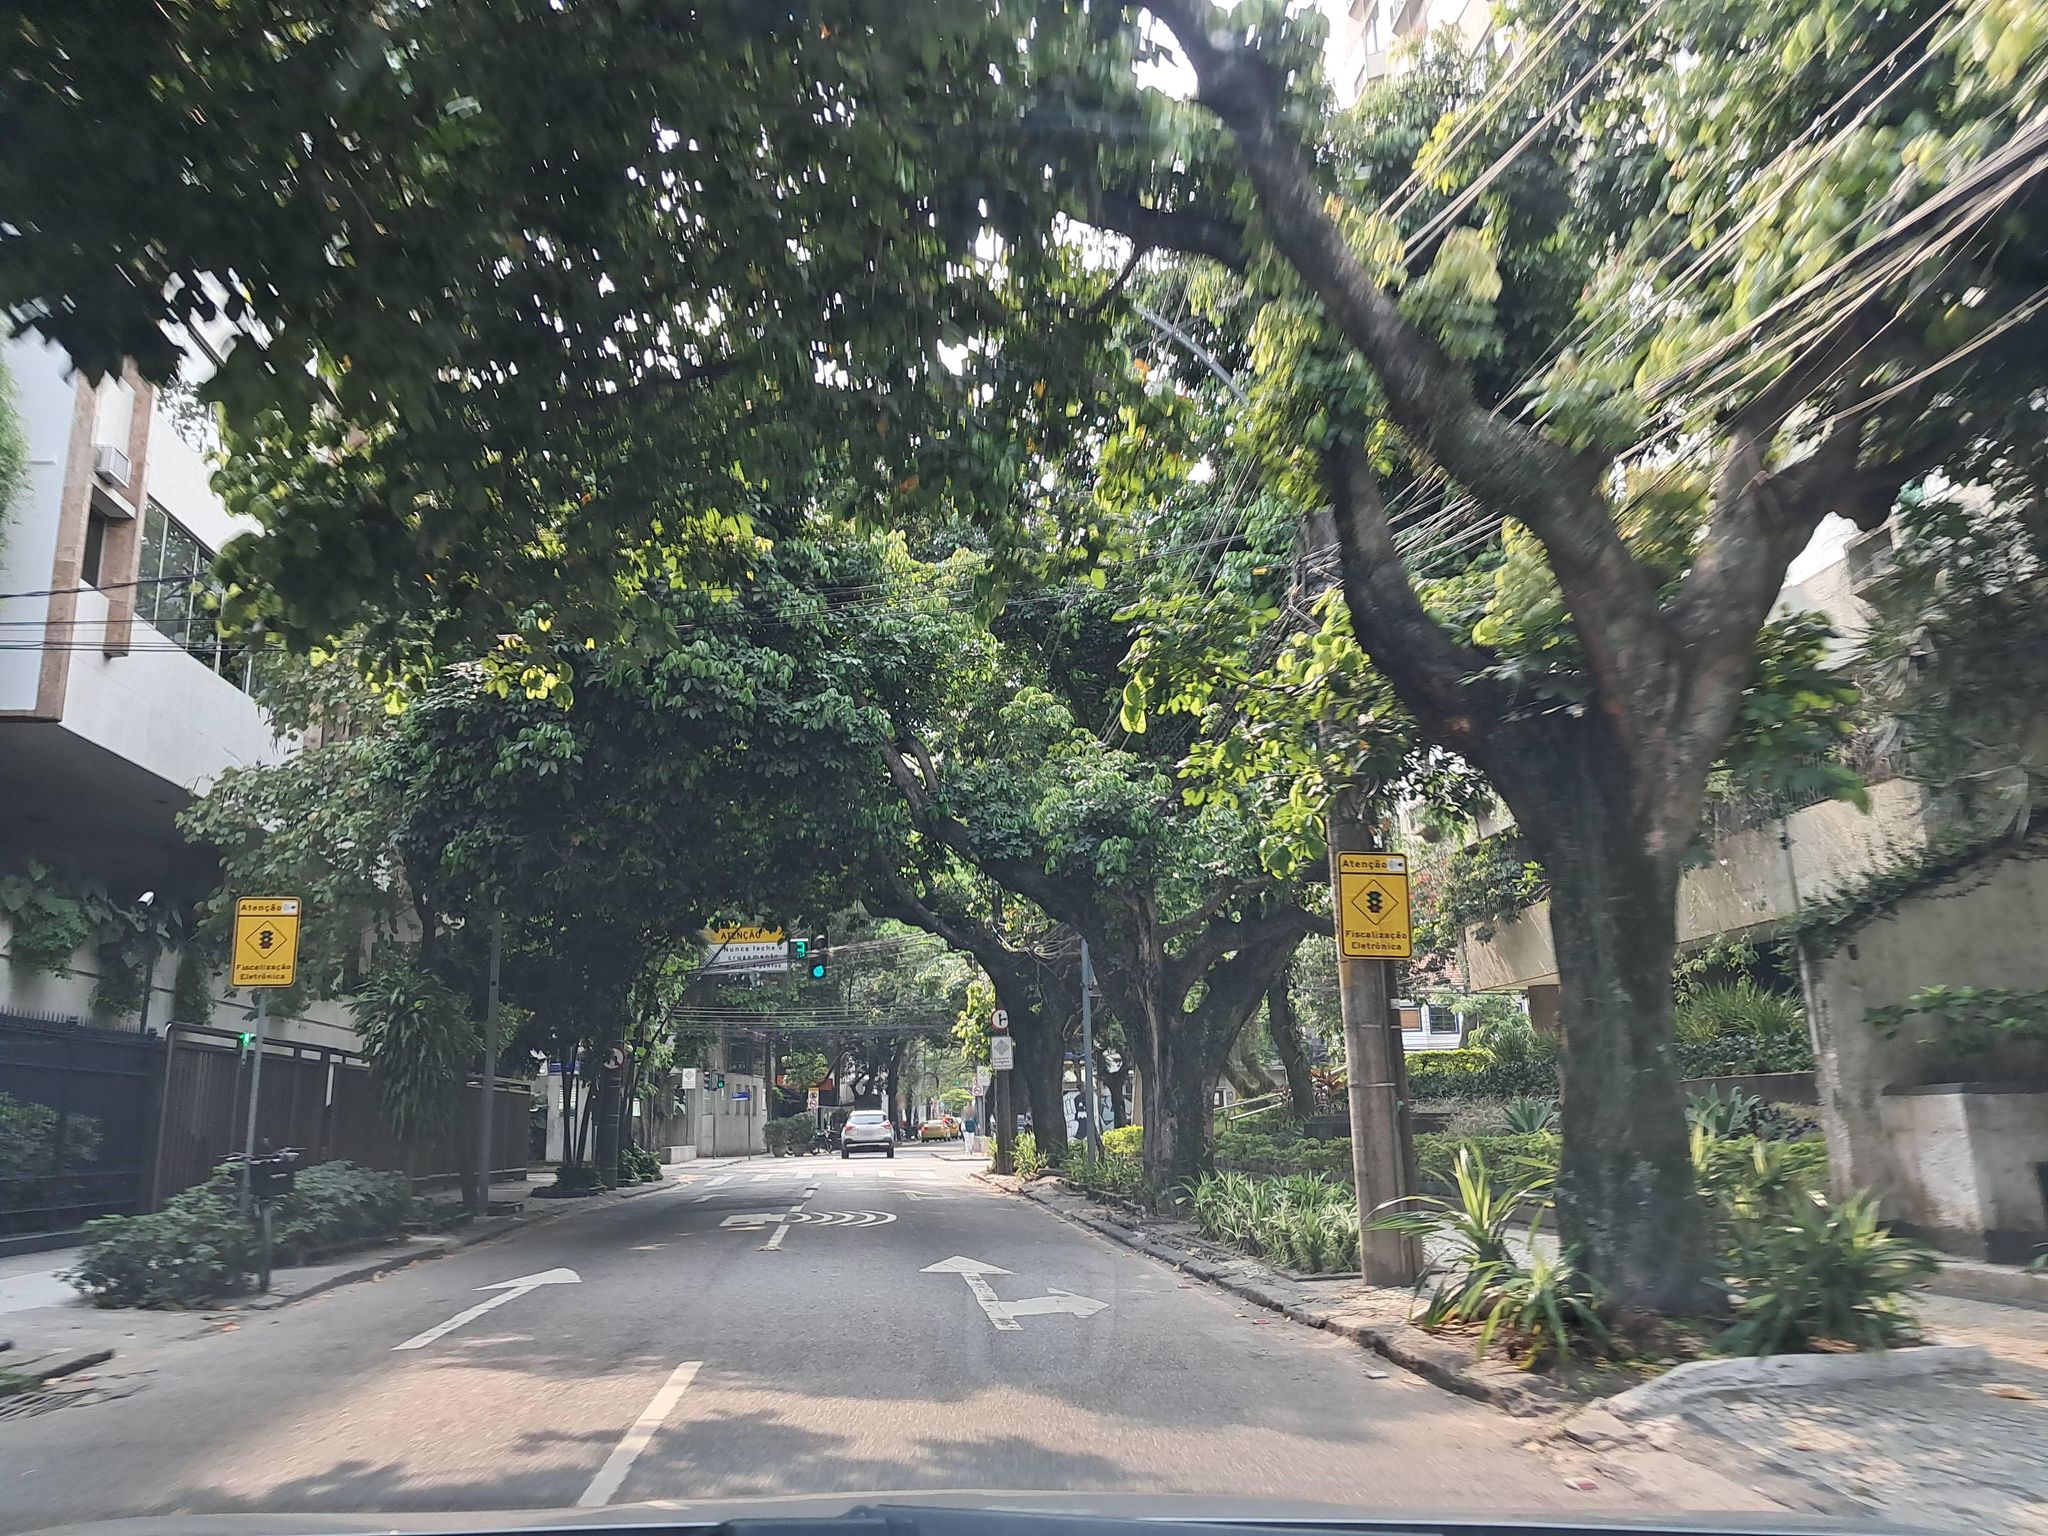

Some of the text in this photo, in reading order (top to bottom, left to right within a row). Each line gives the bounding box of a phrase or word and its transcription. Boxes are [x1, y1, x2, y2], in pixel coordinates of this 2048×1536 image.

[1342, 859, 1387, 869] Atenção
[241, 904, 281, 912] Atenção
[720, 929, 761, 941] ATENÇÃO
[1345, 930, 1407, 939] Fiscalização
[1351, 942, 1402, 950] Eletrônica
